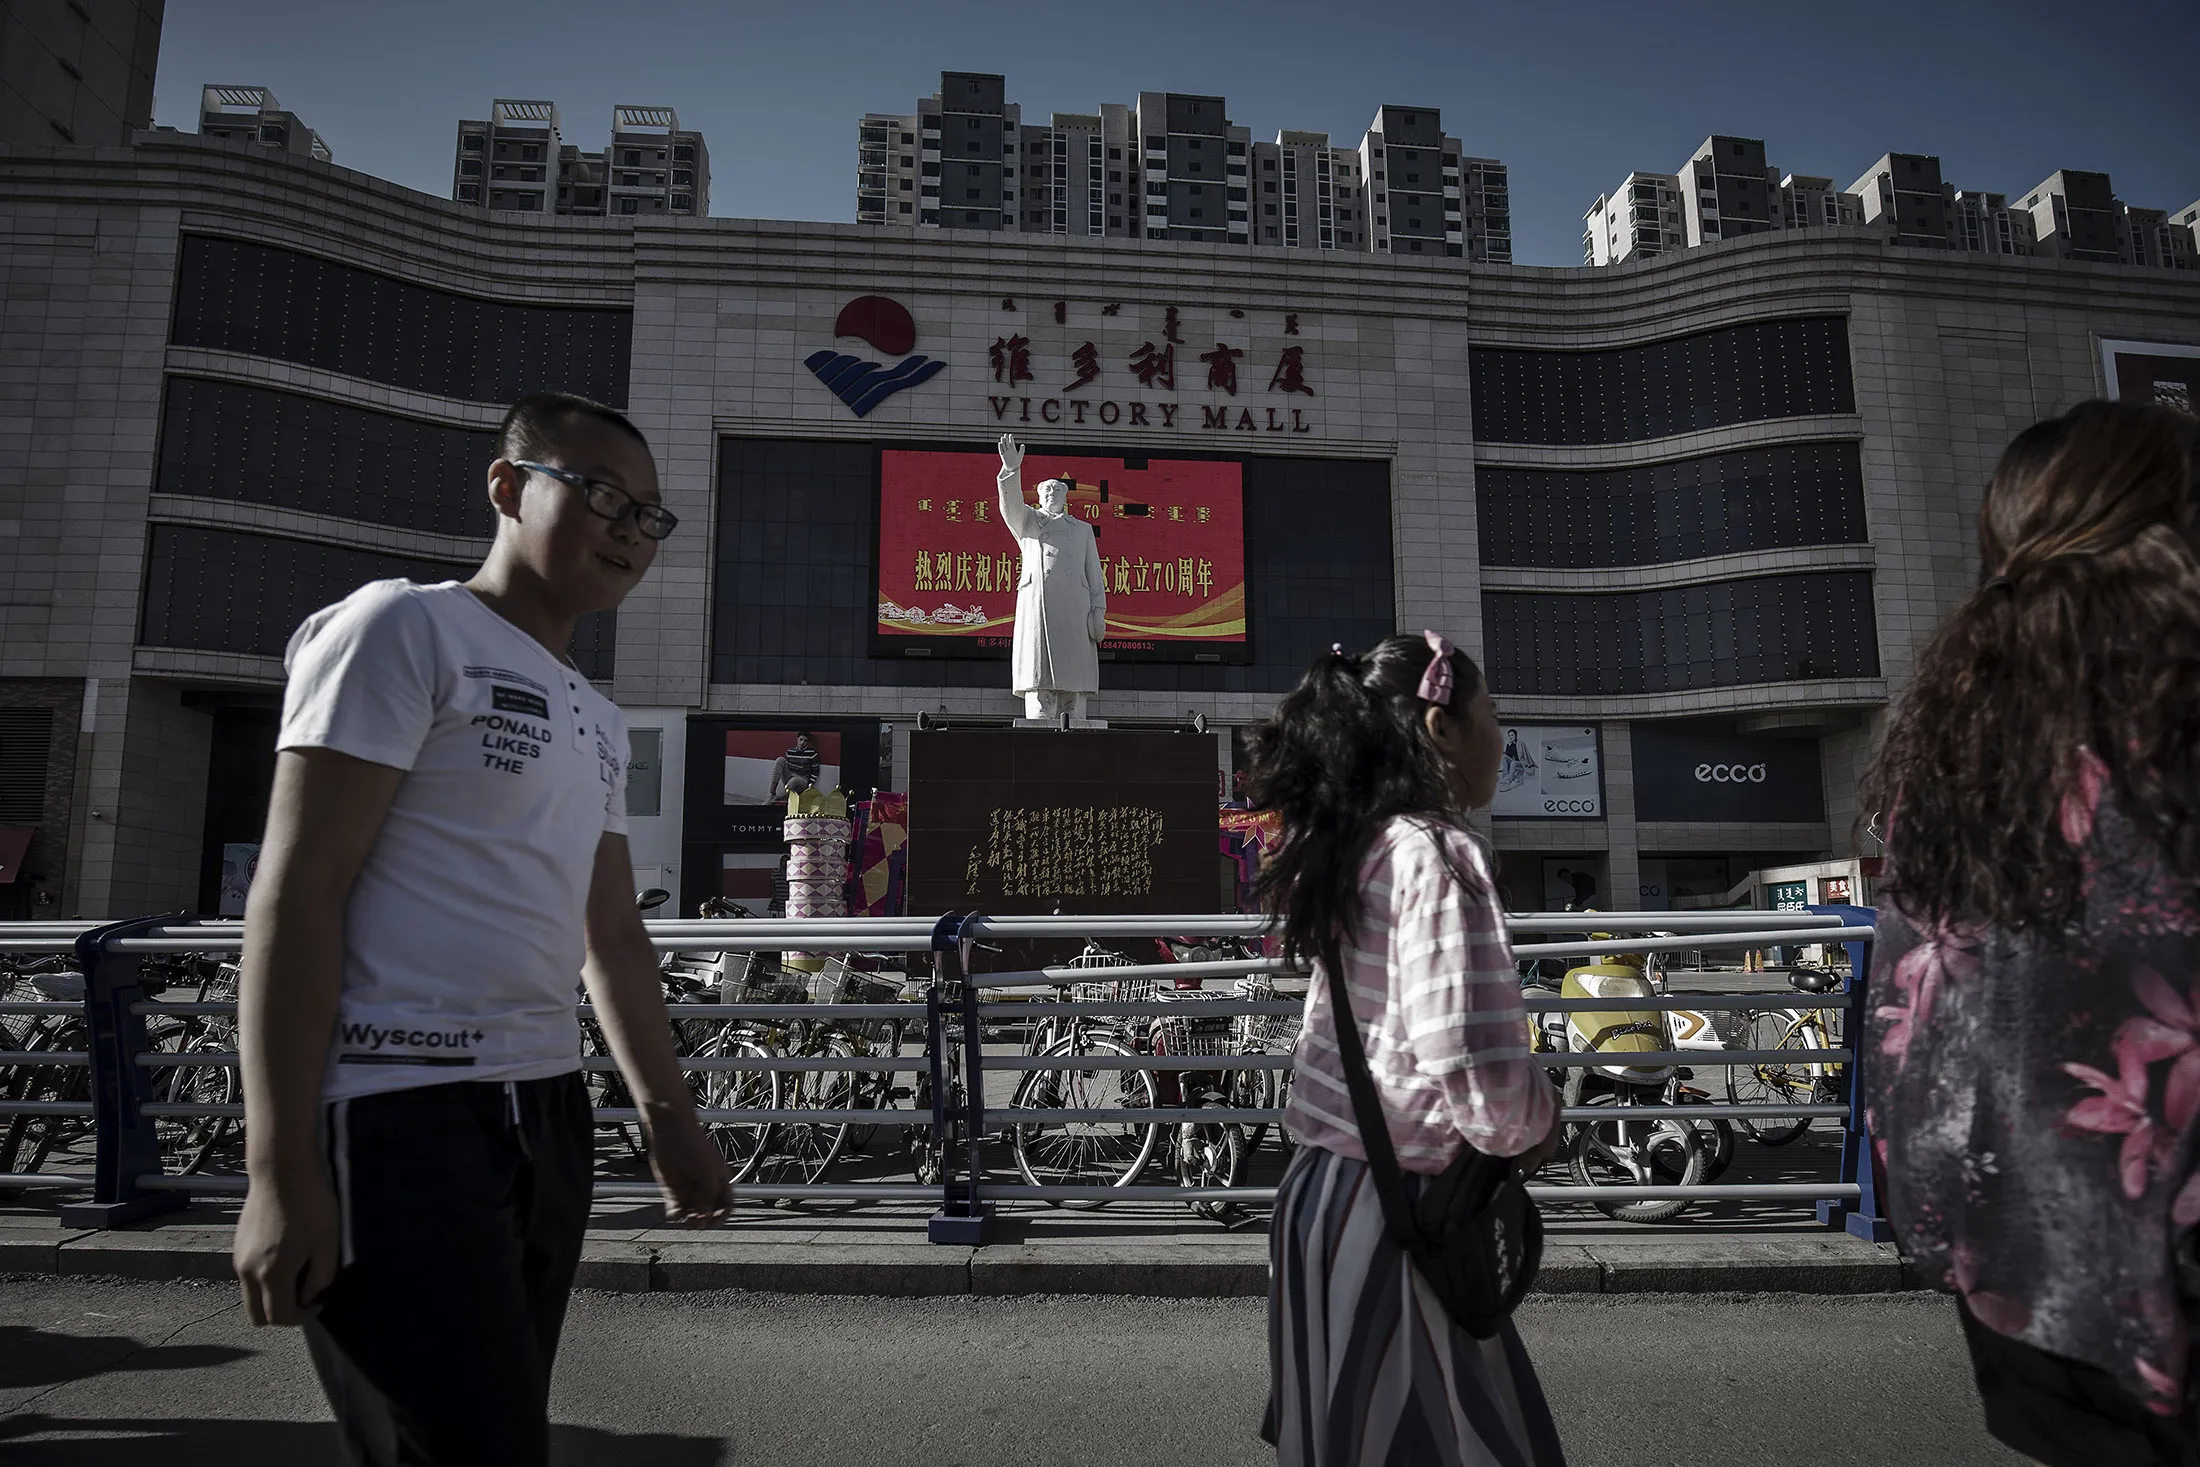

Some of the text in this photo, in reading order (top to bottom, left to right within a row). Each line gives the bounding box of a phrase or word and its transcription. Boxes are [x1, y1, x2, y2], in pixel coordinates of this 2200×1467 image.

[988, 396, 1310, 432] VICTORY MALL
[1083, 503, 1100, 520] 70
[482, 734, 540, 759] LIKES
[483, 754, 524, 774] THE
[1694, 762, 1767, 783] ecco
[1544, 799, 1595, 813] ecco
[731, 825, 773, 833] TOMMY
[341, 1022, 485, 1050] Wyscout+
